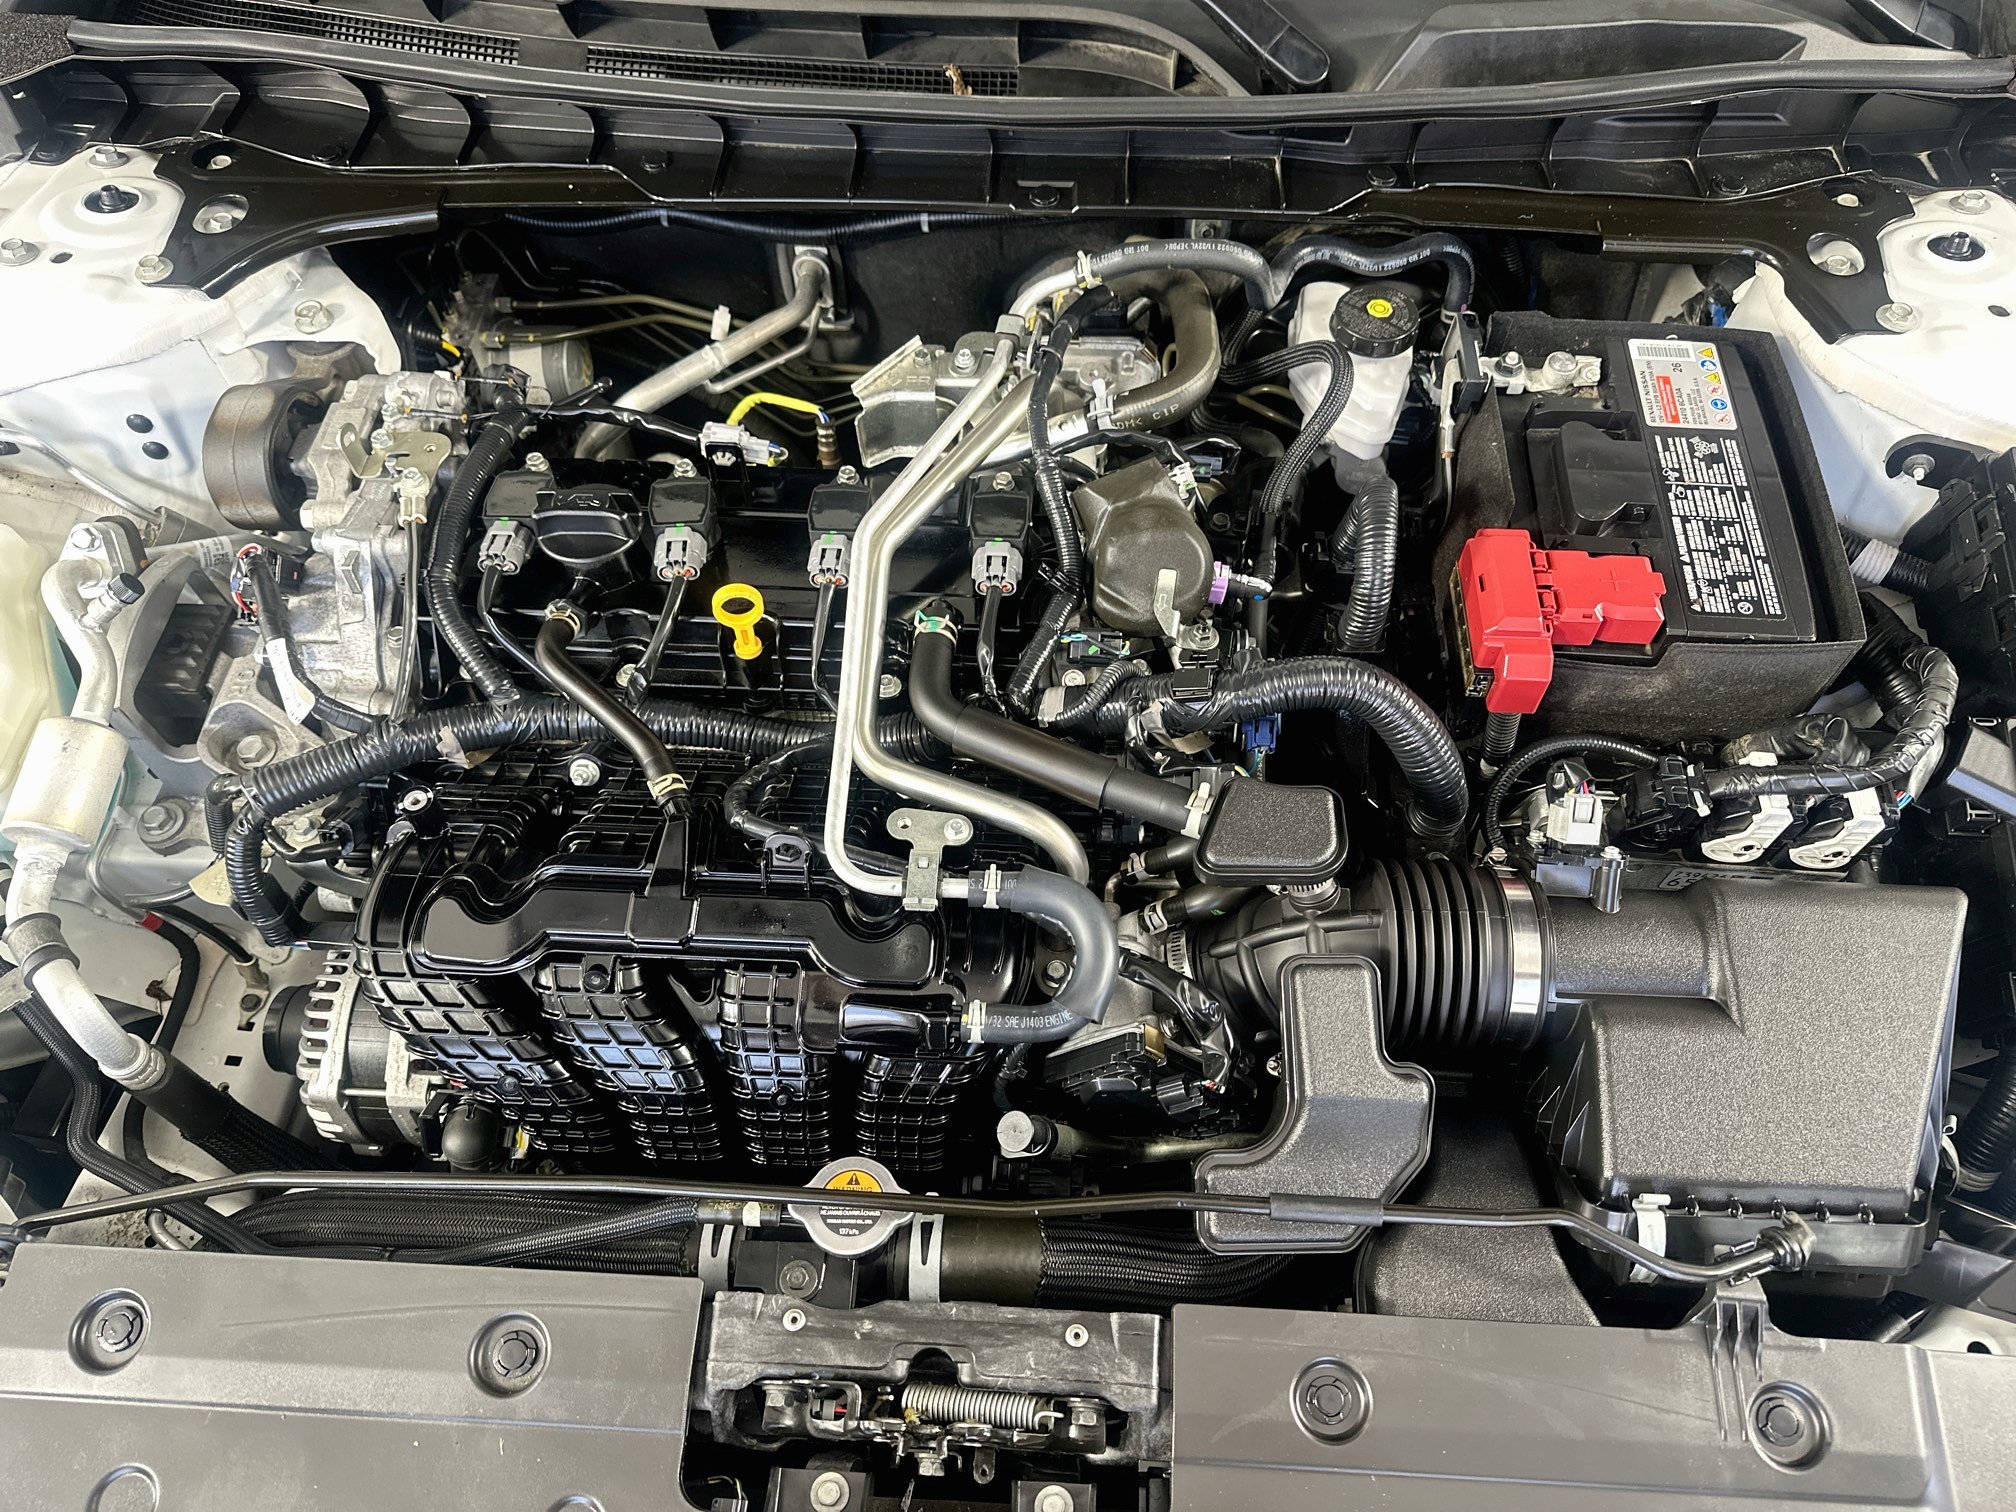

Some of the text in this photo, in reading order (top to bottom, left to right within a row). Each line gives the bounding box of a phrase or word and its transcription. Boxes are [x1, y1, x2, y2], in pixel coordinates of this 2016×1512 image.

[1670, 362, 1683, 372] 26
[1639, 370, 1656, 422] RENAULT NISSAN
[1152, 403, 1180, 420] CIP
[1004, 1016, 1019, 1028] SAE
[1020, 1016, 1044, 1028] J1403
[1044, 1010, 1074, 1027] ENGINE
